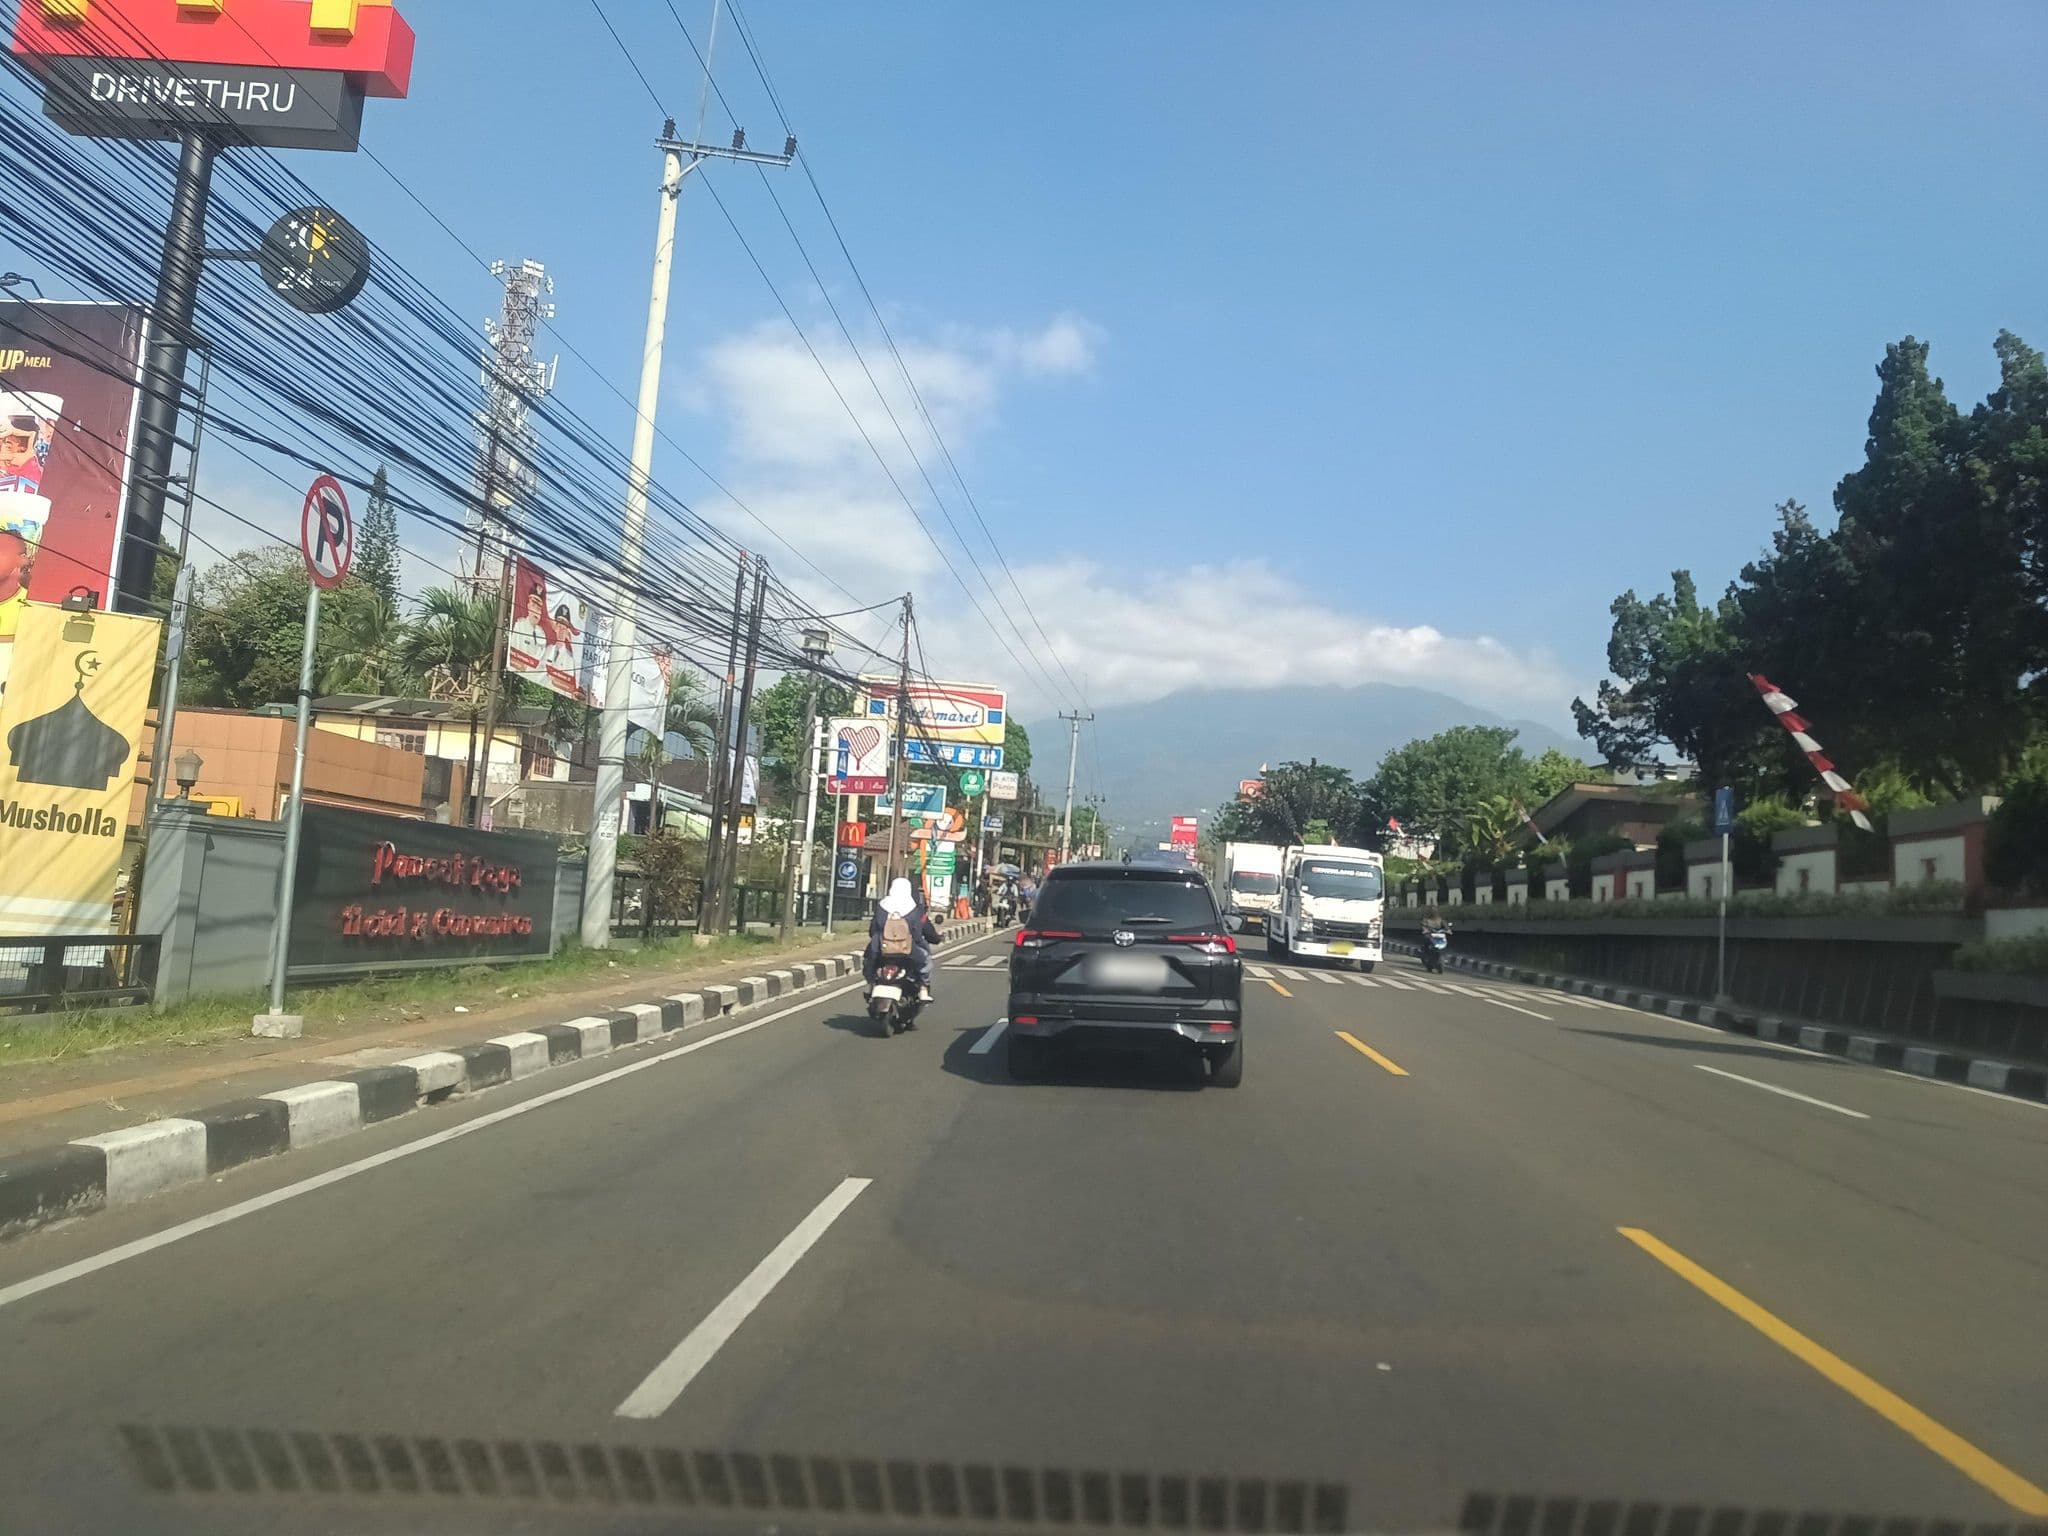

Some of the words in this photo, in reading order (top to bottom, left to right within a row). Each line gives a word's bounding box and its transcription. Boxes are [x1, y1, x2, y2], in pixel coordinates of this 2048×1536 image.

[24, 356, 52, 368] MEAL
[895, 702, 979, 724] domaret
[0, 798, 117, 837] Musholla
